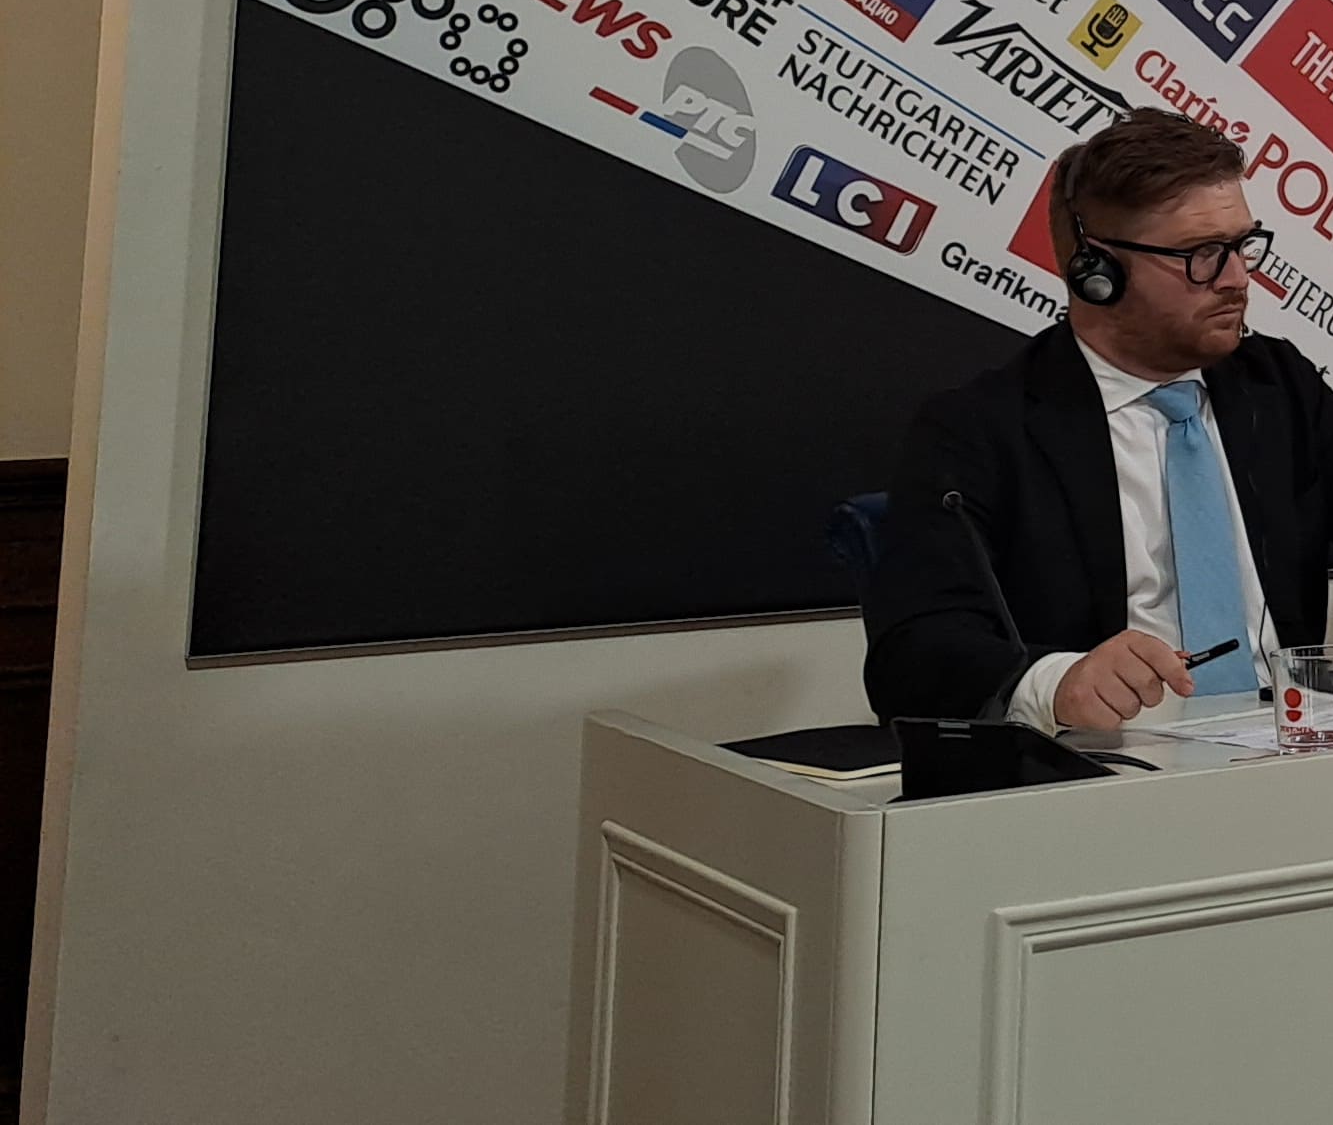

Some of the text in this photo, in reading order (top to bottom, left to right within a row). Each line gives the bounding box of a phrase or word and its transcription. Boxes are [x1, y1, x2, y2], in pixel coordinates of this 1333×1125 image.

[777, 52, 1008, 206] NACHRICHTEN
[796, 26, 1021, 179] STUTTGARTER
[789, 154, 921, 247] LCI
